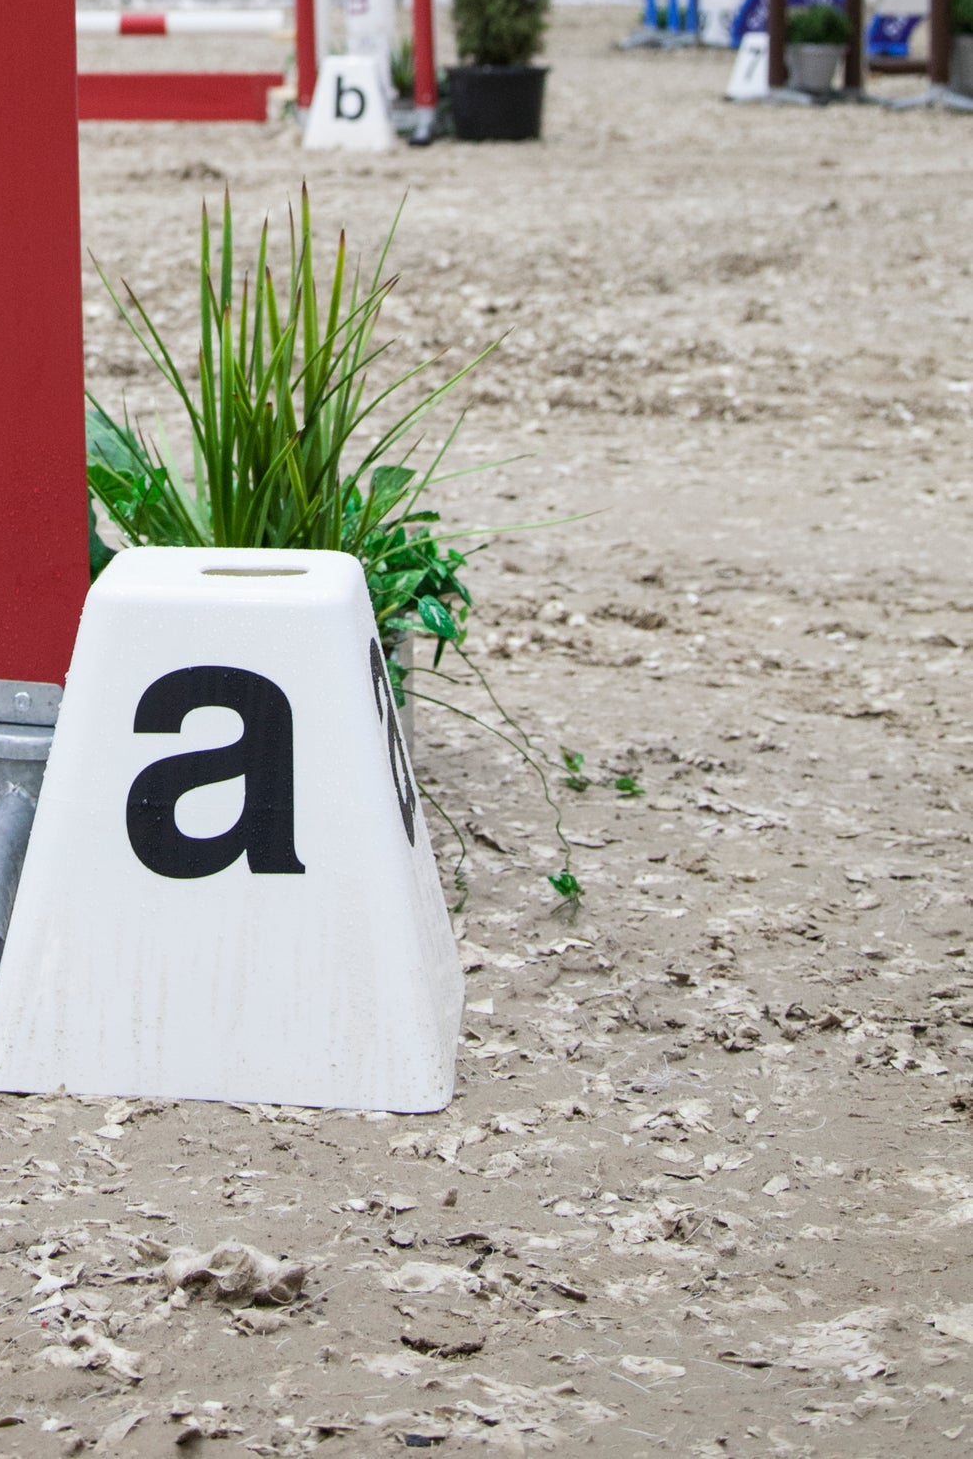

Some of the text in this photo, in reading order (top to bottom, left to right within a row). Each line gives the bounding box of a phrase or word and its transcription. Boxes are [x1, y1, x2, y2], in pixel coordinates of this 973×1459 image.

[745, 45, 763, 81] 7
[334, 75, 366, 121] b
[125, 665, 306, 880] a
